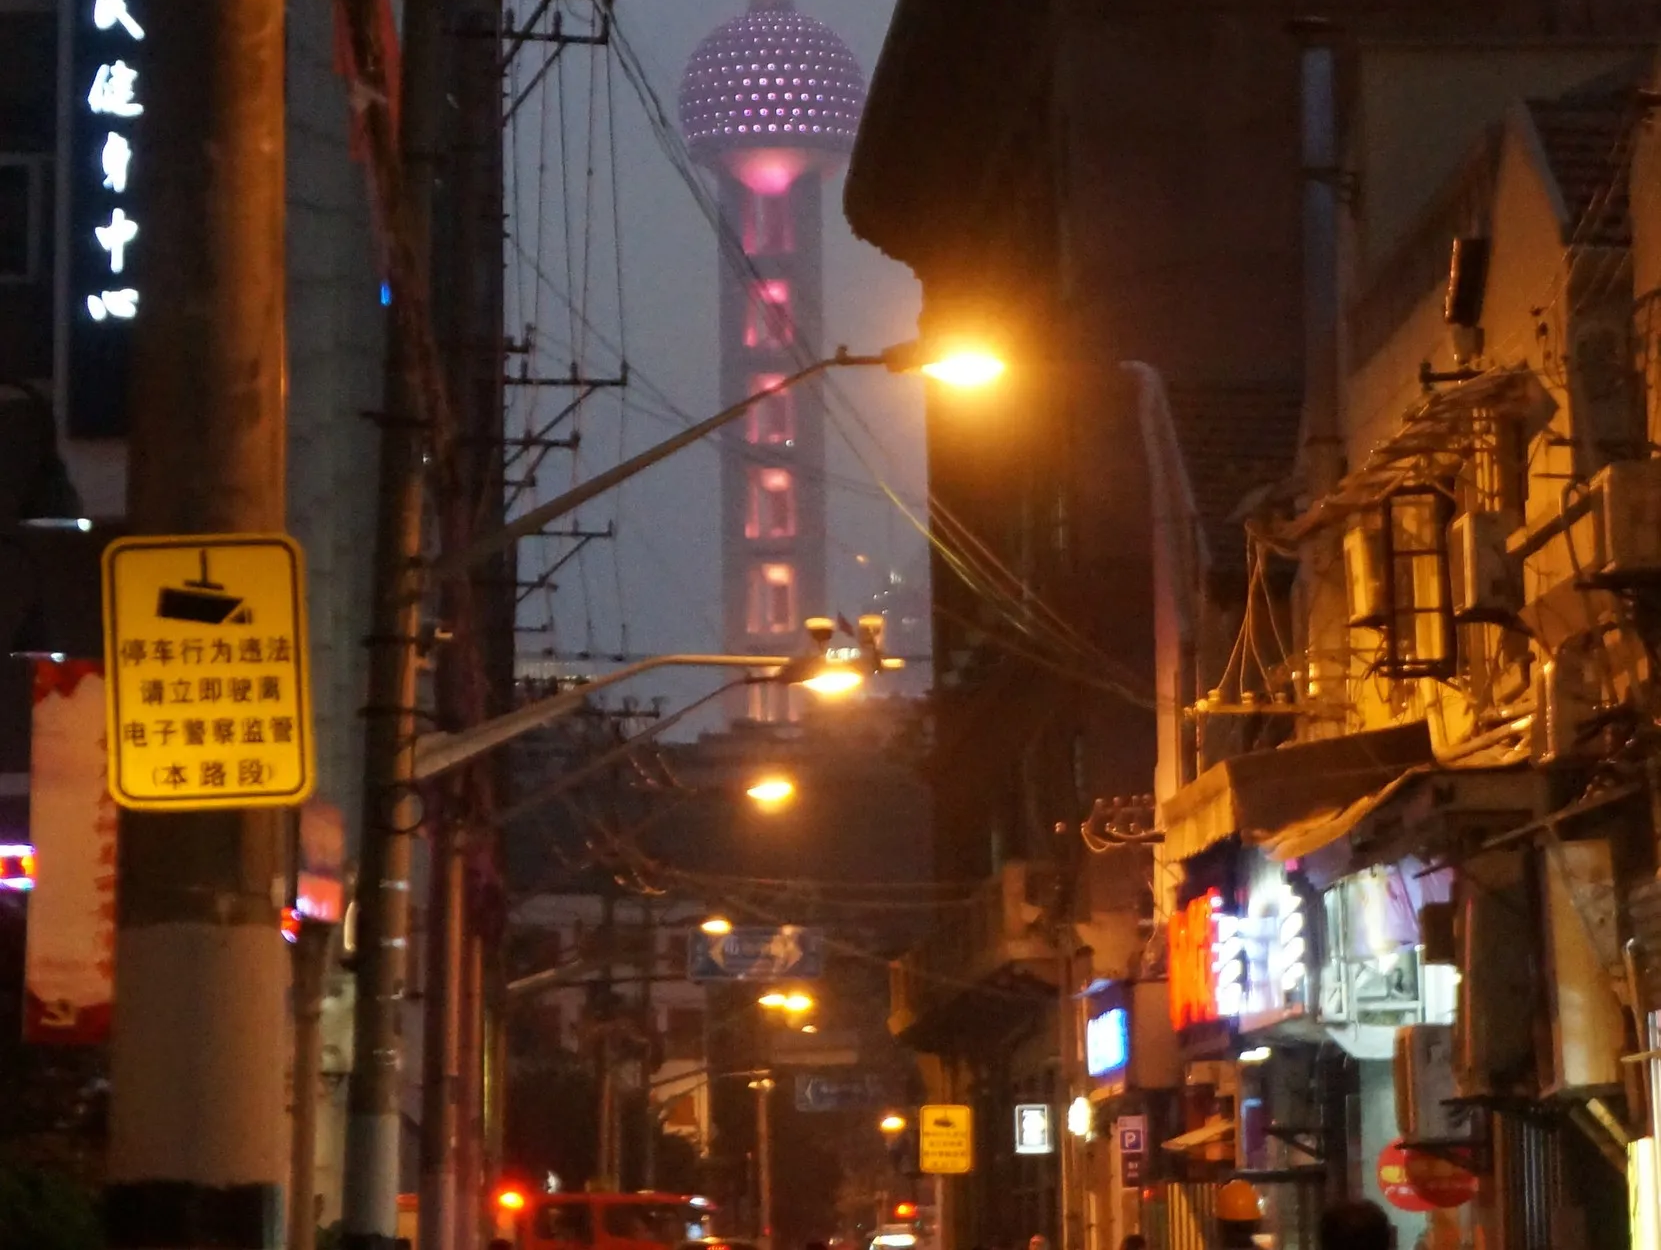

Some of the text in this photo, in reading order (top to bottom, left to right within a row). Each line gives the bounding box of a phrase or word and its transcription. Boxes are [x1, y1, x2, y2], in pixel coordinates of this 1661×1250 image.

[121, 636, 292, 666] 停车行为违法
[140, 676, 282, 706] 请立即驶离
[123, 716, 293, 747] 电子警察监管
[151, 758, 275, 789] (本路段)
[1124, 1131, 1136, 1148] P
